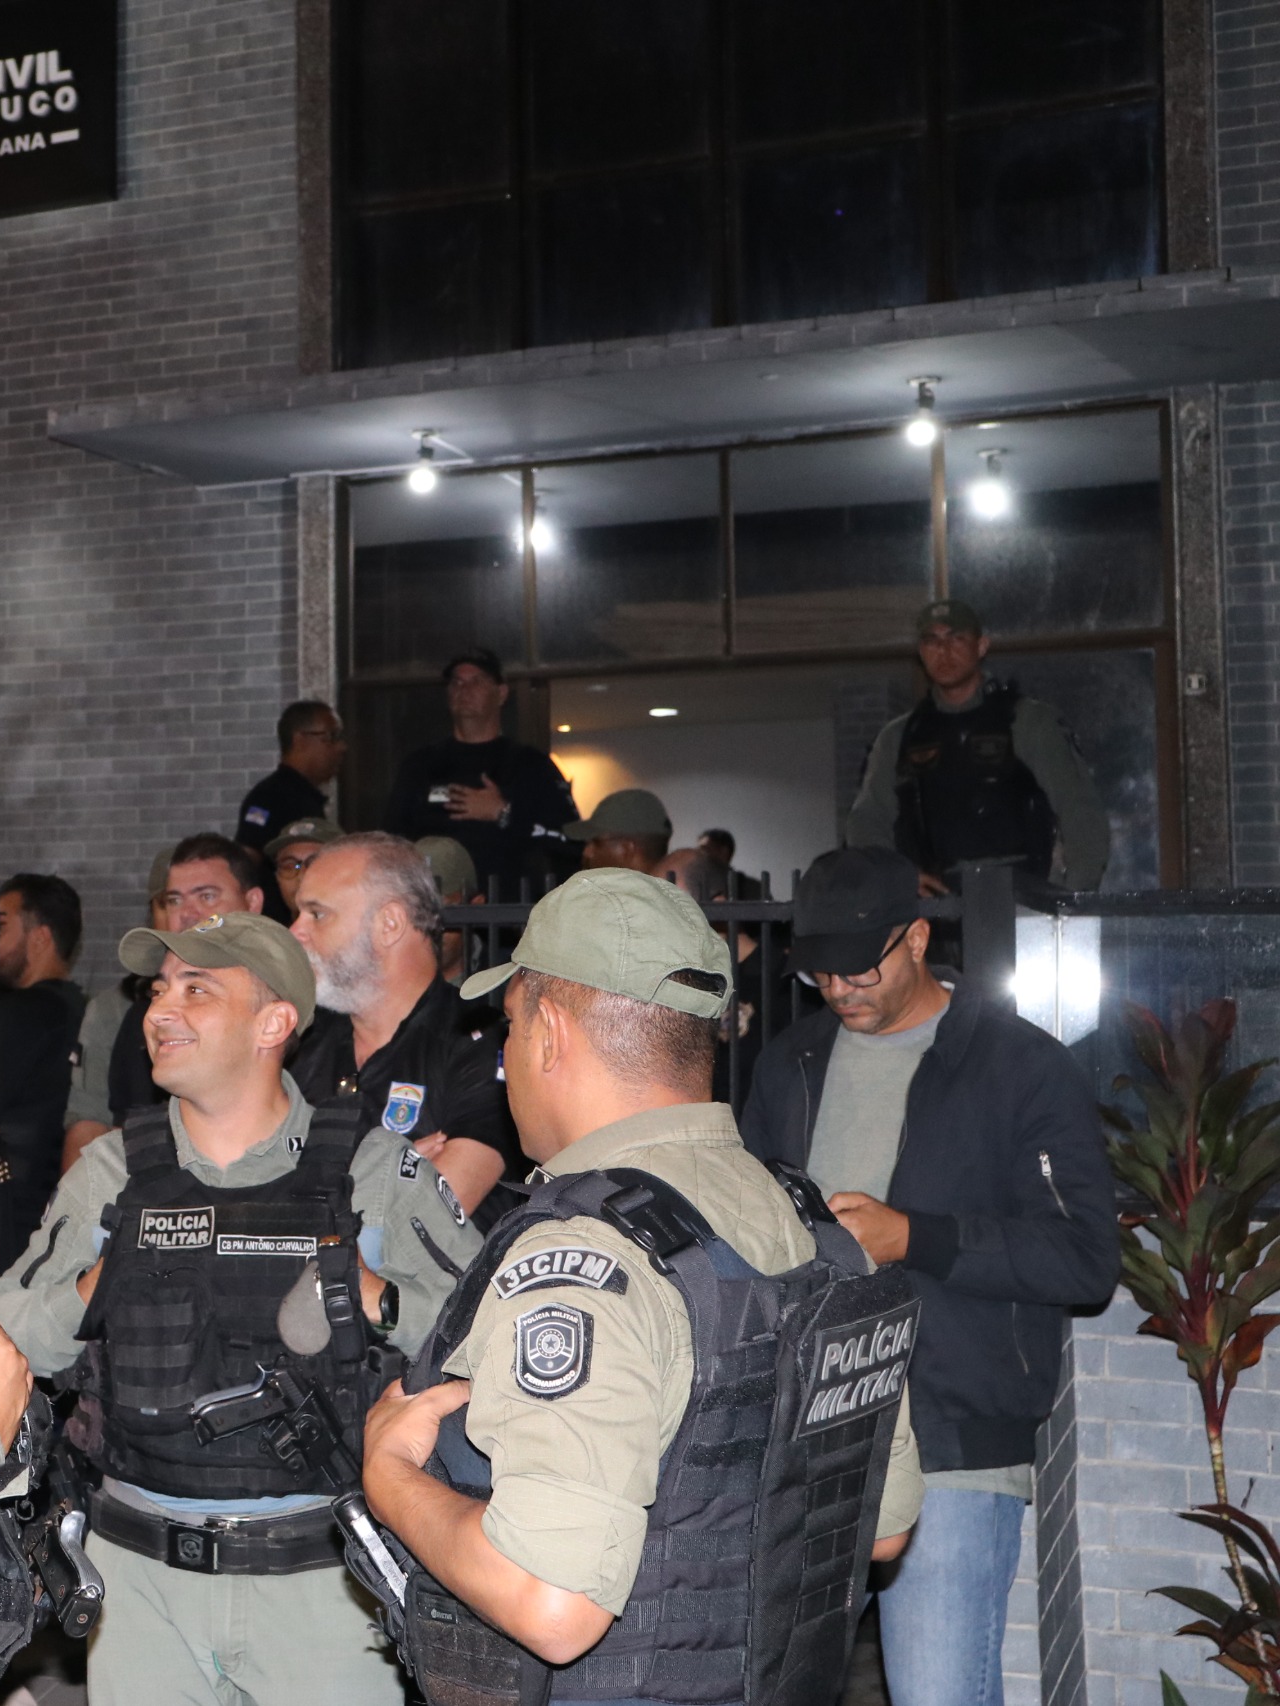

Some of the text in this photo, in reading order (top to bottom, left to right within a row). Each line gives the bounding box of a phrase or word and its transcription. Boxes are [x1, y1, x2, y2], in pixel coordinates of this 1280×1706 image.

[145, 1213, 210, 1231] POLÍCIA
[143, 1231, 209, 1246] MILITAR
[233, 1240, 244, 1250] PM
[245, 1238, 275, 1251] ANTÔNIO
[276, 1242, 314, 1252] CARVALHO
[504, 1252, 608, 1289] 3ªCIPM
[523, 1311, 579, 1327] POLÍCIA MILITAR
[821, 1317, 913, 1381] POLÍCIA
[524, 1370, 576, 1388] PERNAMBUCO
[806, 1360, 905, 1425] MILITAR
